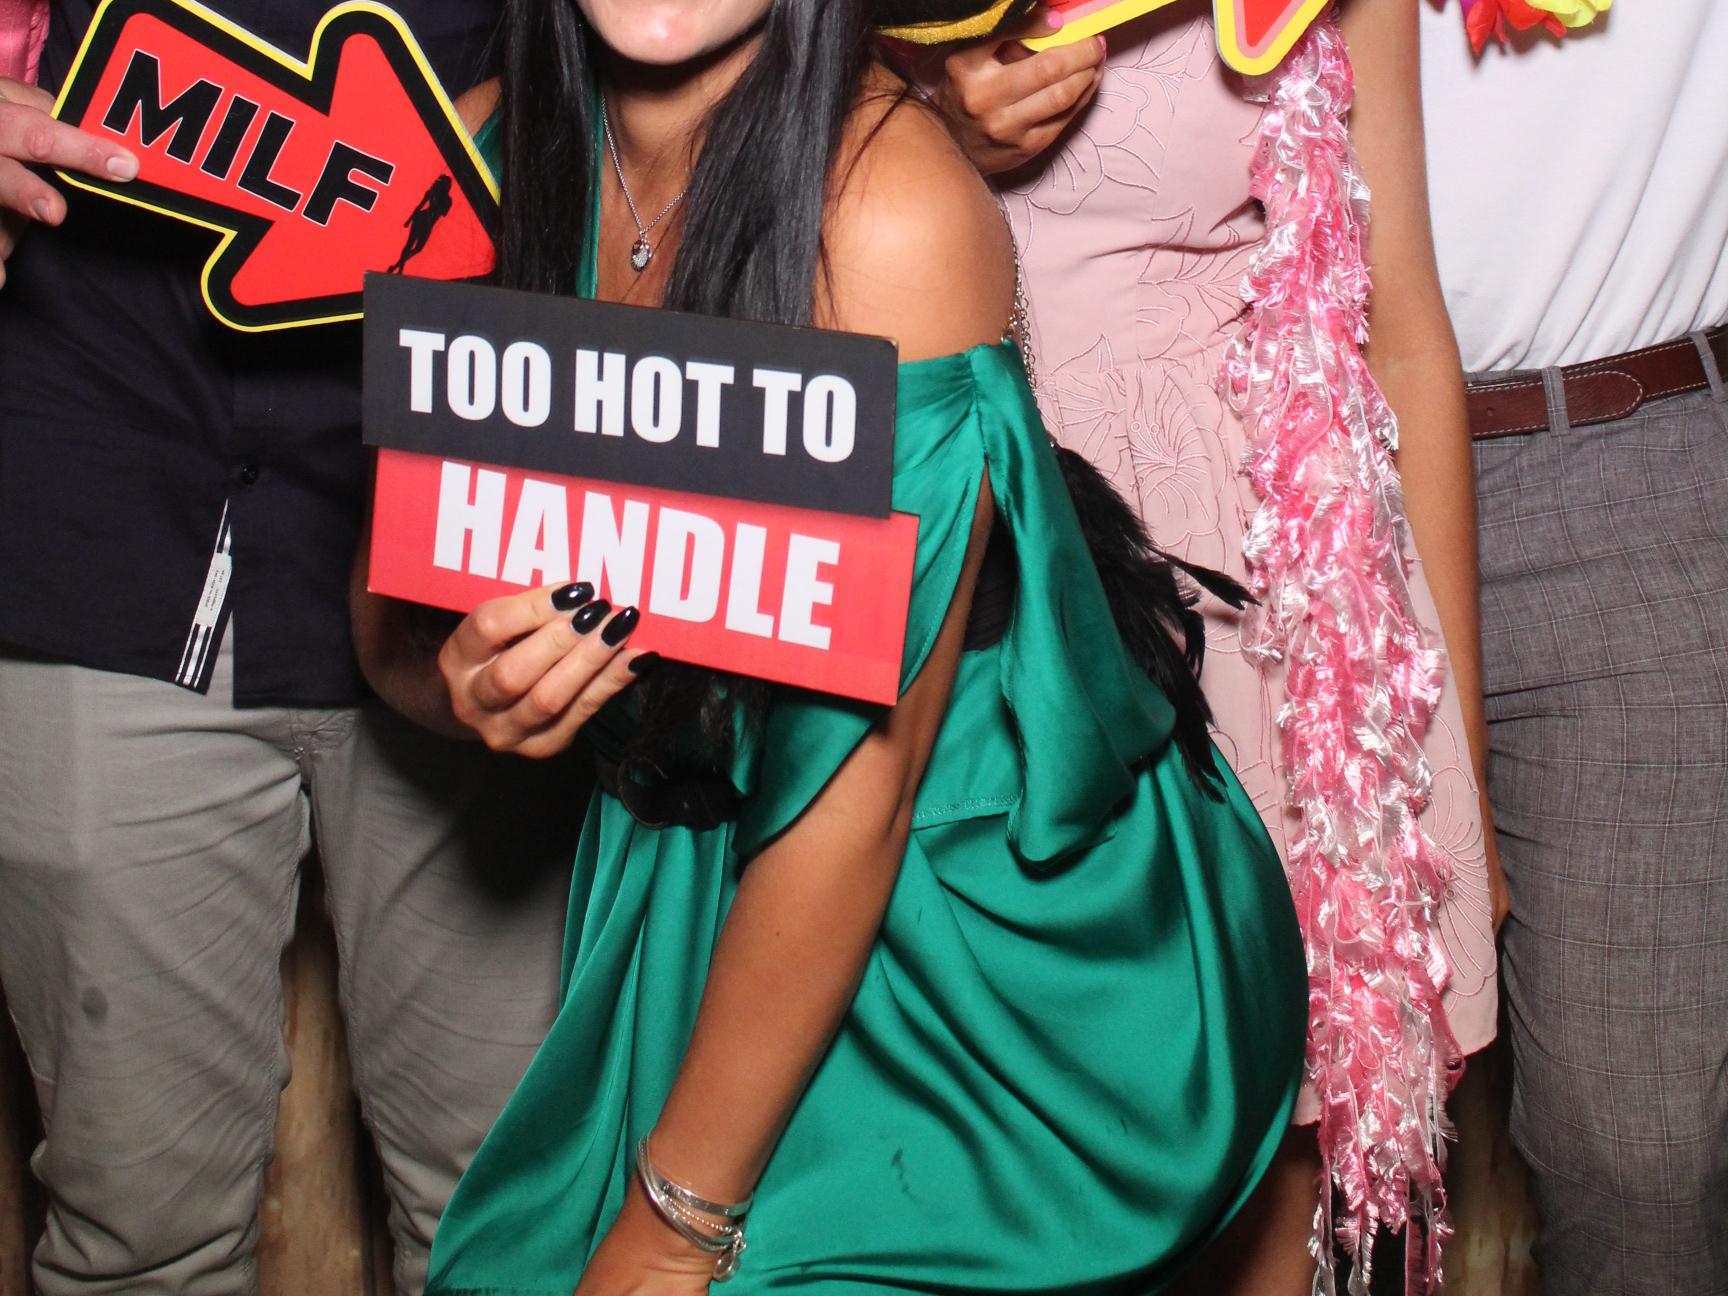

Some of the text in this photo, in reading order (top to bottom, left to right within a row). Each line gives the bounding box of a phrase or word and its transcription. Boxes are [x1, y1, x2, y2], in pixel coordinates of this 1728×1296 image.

[101, 48, 396, 227] MILF
[399, 328, 858, 464] TOO HOT TO
[432, 460, 841, 652] HANDLE
